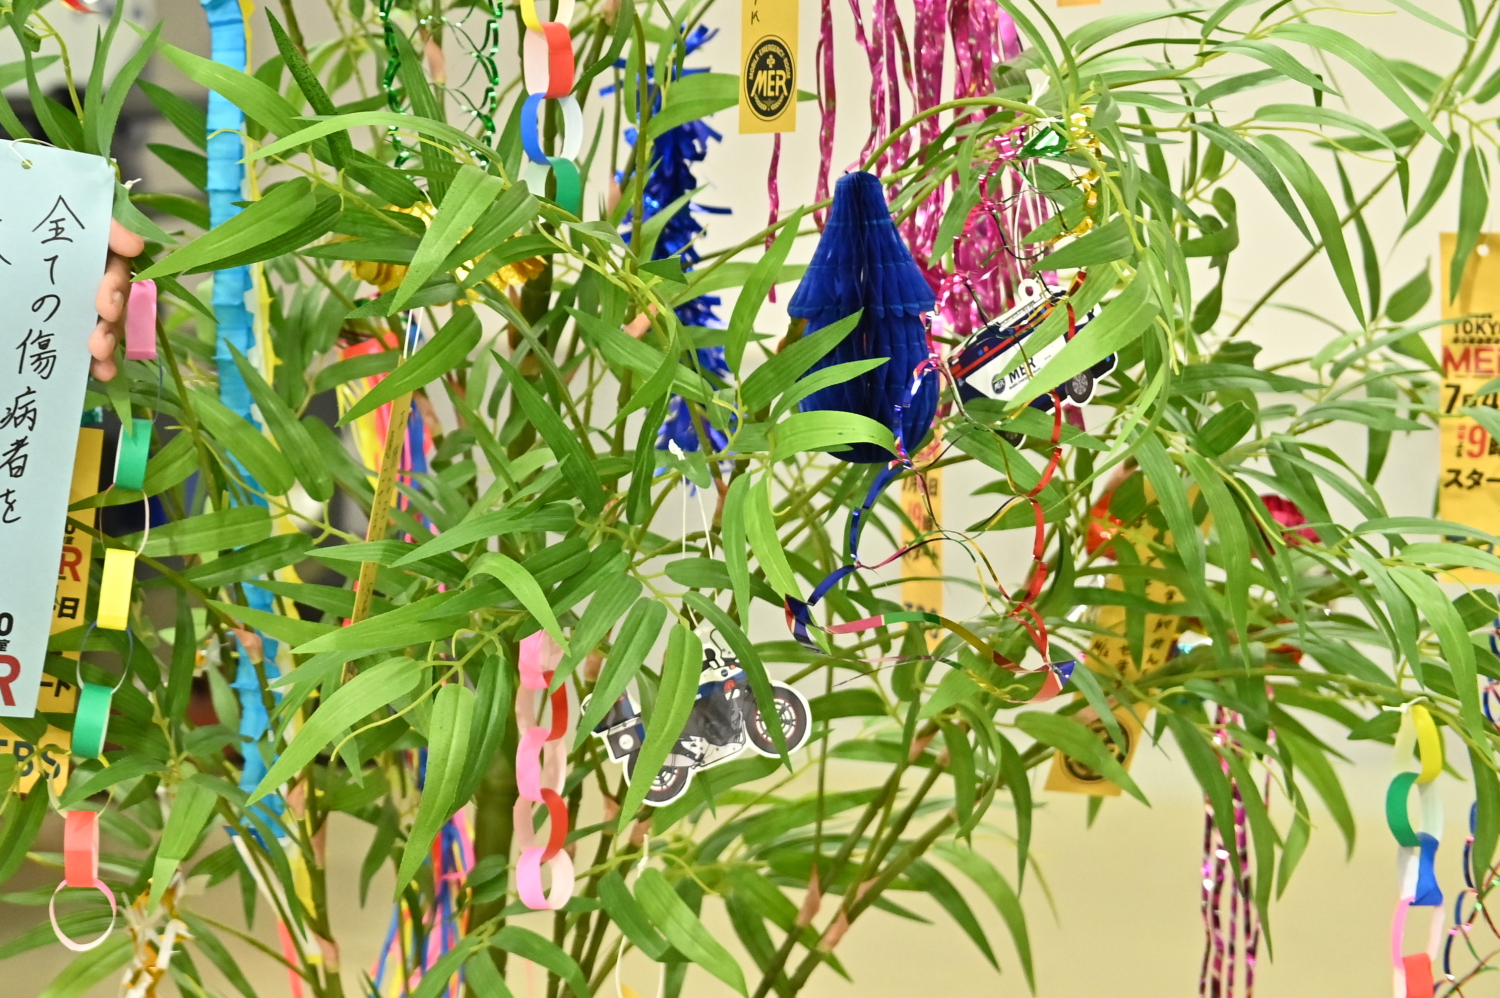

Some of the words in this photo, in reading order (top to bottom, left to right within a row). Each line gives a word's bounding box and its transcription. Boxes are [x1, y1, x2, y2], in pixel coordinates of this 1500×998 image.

[750, 69, 788, 97] MER
[1453, 319, 1500, 336] TOKY
[1442, 345, 1500, 375] ME
